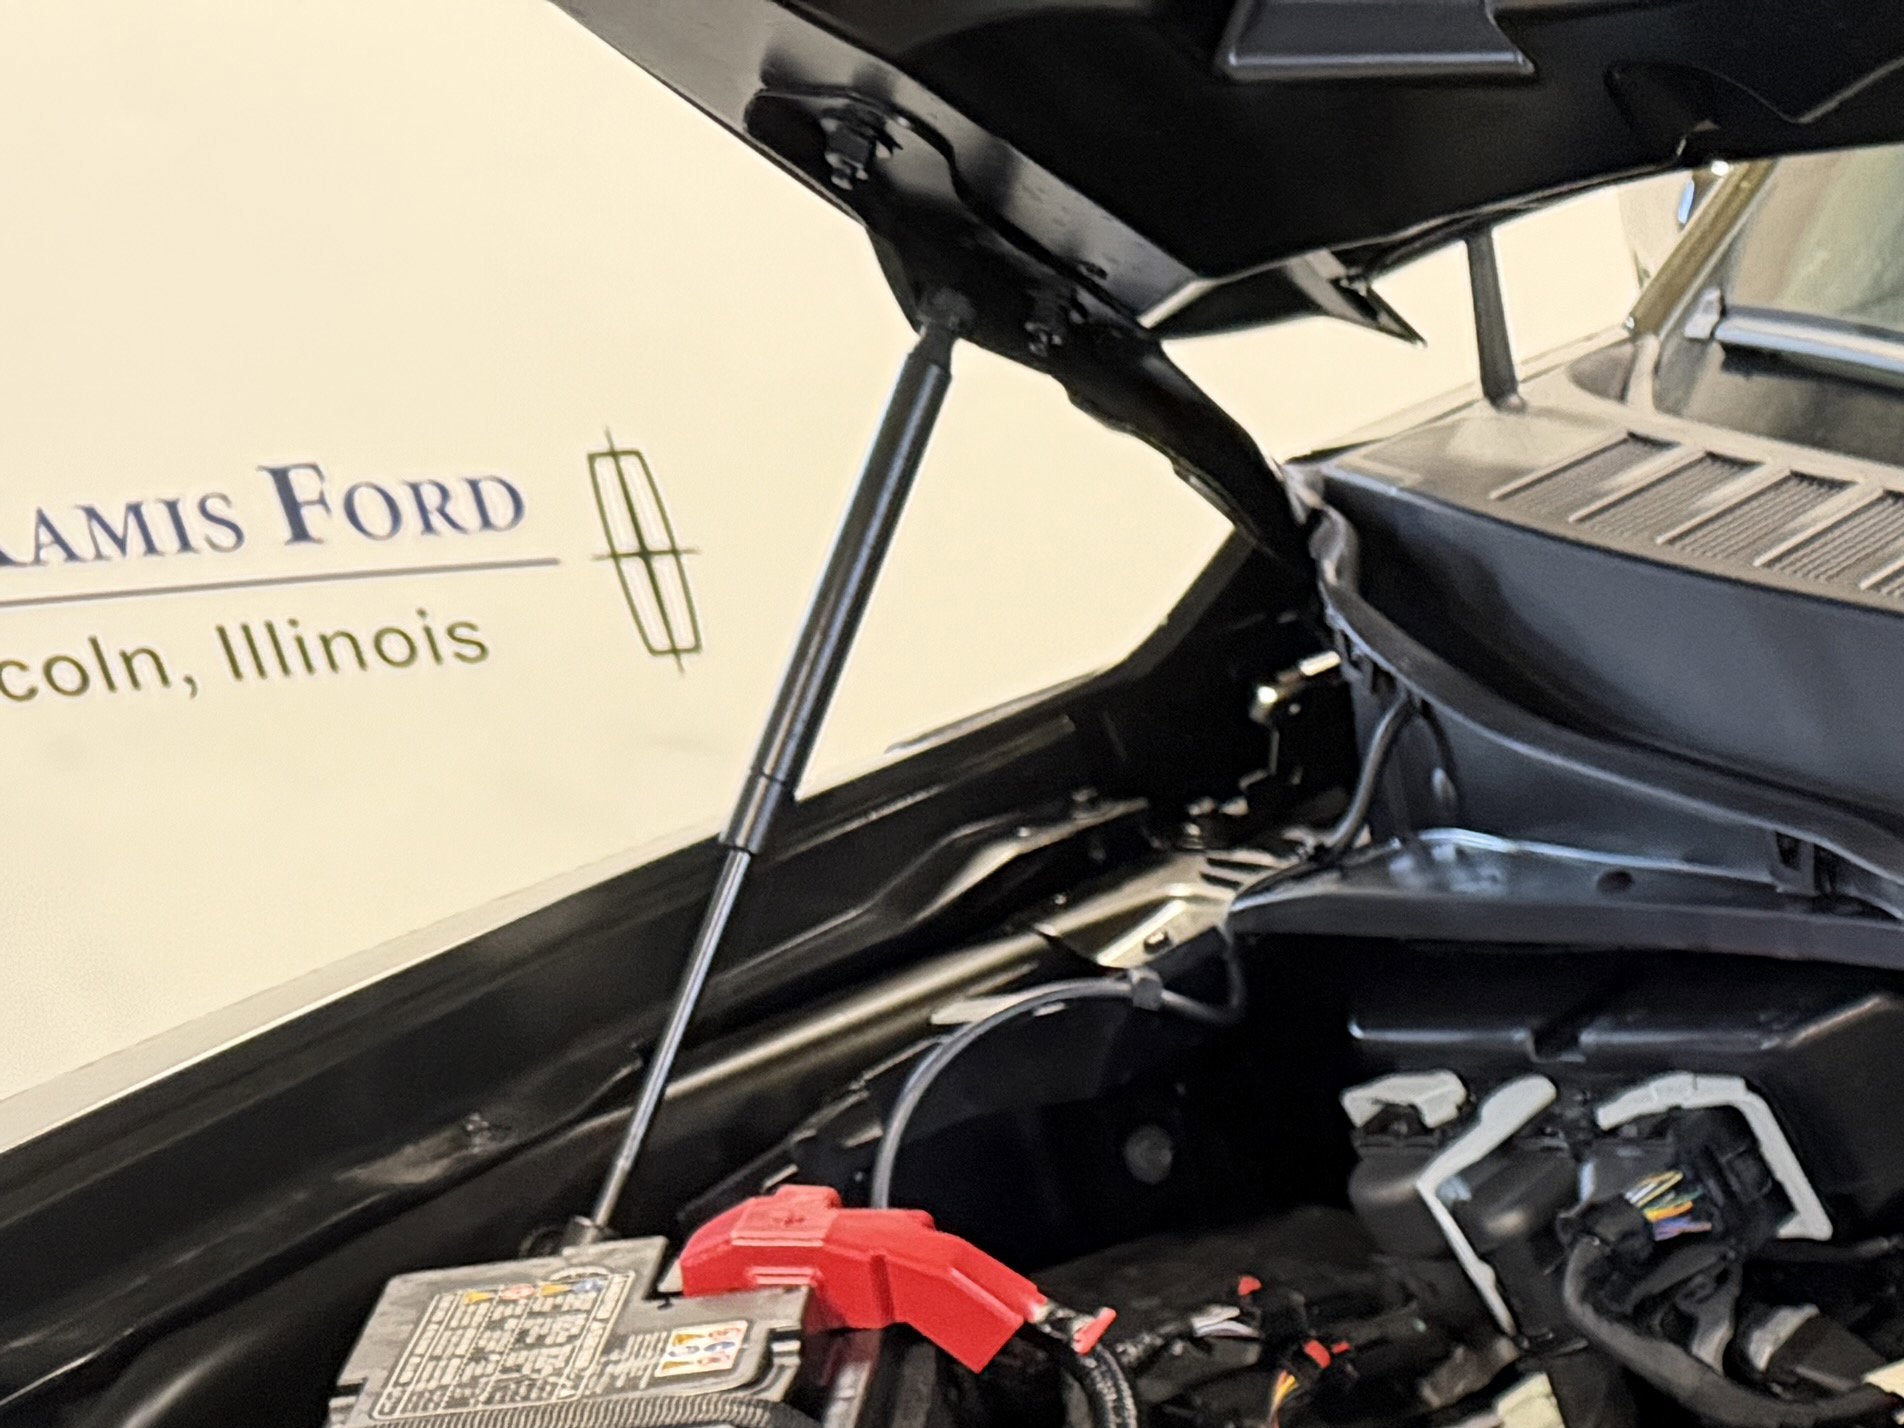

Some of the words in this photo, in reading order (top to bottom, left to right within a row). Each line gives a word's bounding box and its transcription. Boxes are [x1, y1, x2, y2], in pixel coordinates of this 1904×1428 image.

[0, 491, 245, 567] AMIS
[256, 462, 525, 545] FORD
[214, 606, 489, 681] Illinois
